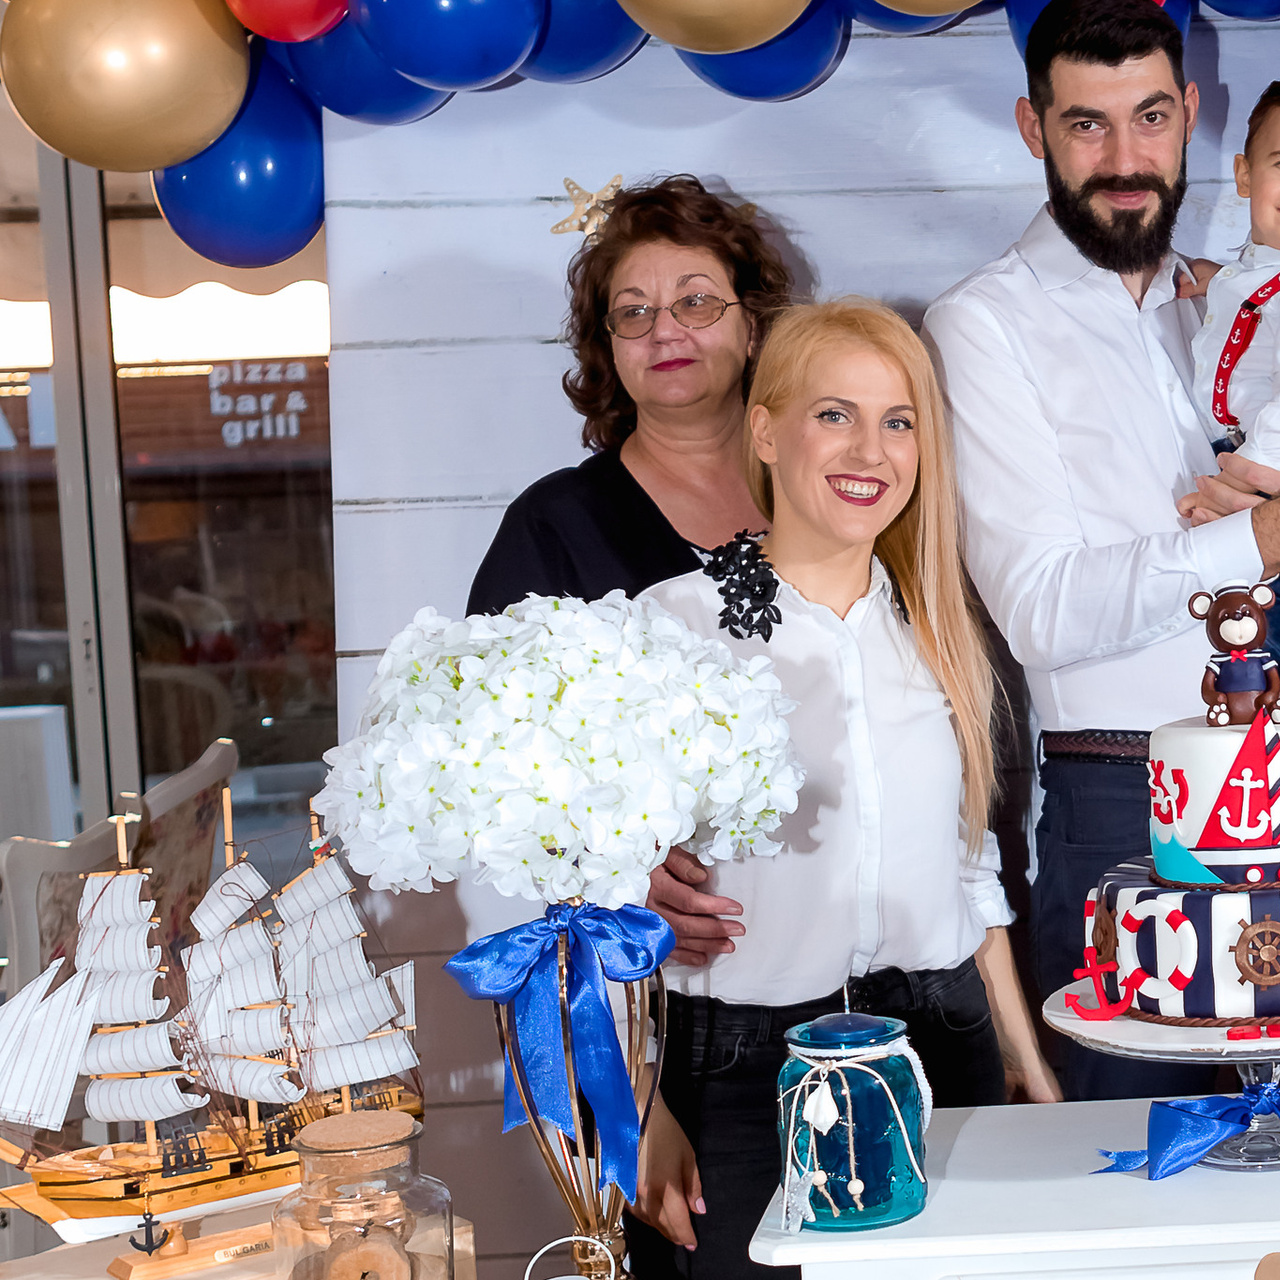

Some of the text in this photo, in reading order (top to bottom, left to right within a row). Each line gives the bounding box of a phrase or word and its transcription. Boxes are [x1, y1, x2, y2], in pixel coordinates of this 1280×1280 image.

[208, 361, 307, 389] pizza
[210, 388, 308, 415] bar &
[222, 412, 299, 448] grill
[223, 1241, 271, 1258] BULGARIA
